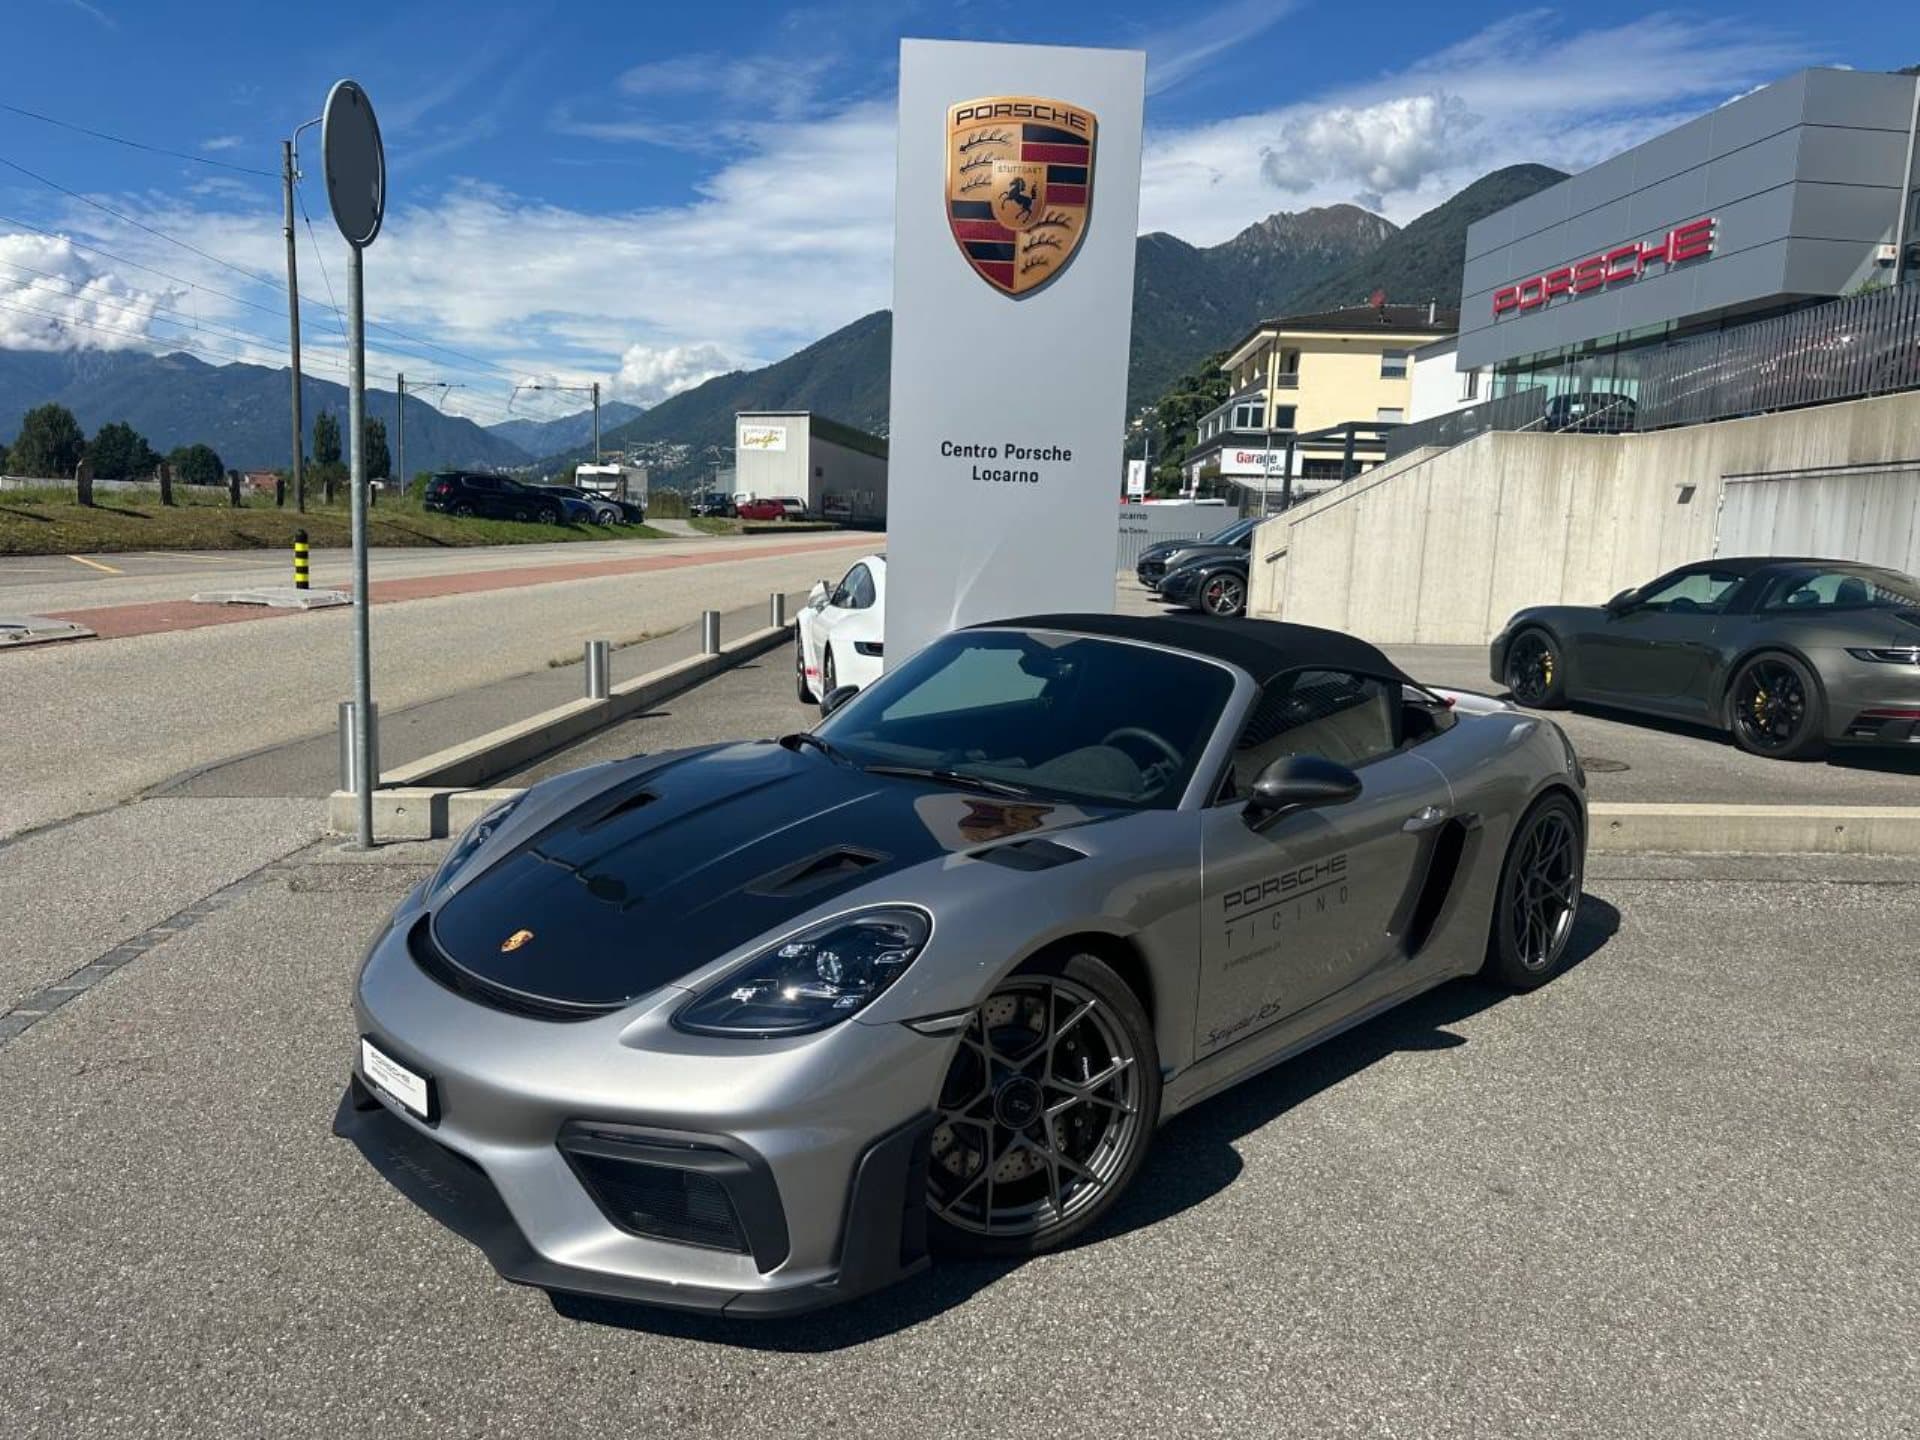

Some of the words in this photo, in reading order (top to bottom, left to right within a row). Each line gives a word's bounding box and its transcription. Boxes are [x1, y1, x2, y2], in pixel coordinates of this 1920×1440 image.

[956, 103, 1088, 132] PORSCHE
[997, 165, 1043, 175] STUTTGART
[1493, 217, 1718, 316] PORSCHE
[940, 440, 998, 459] Centro
[1004, 443, 1072, 461] Porsche
[1236, 451, 1278, 468] Garage
[972, 465, 1039, 483] Locarno
[1223, 853, 1347, 912] PORSCHE
[1224, 885, 1348, 949] TICINO
